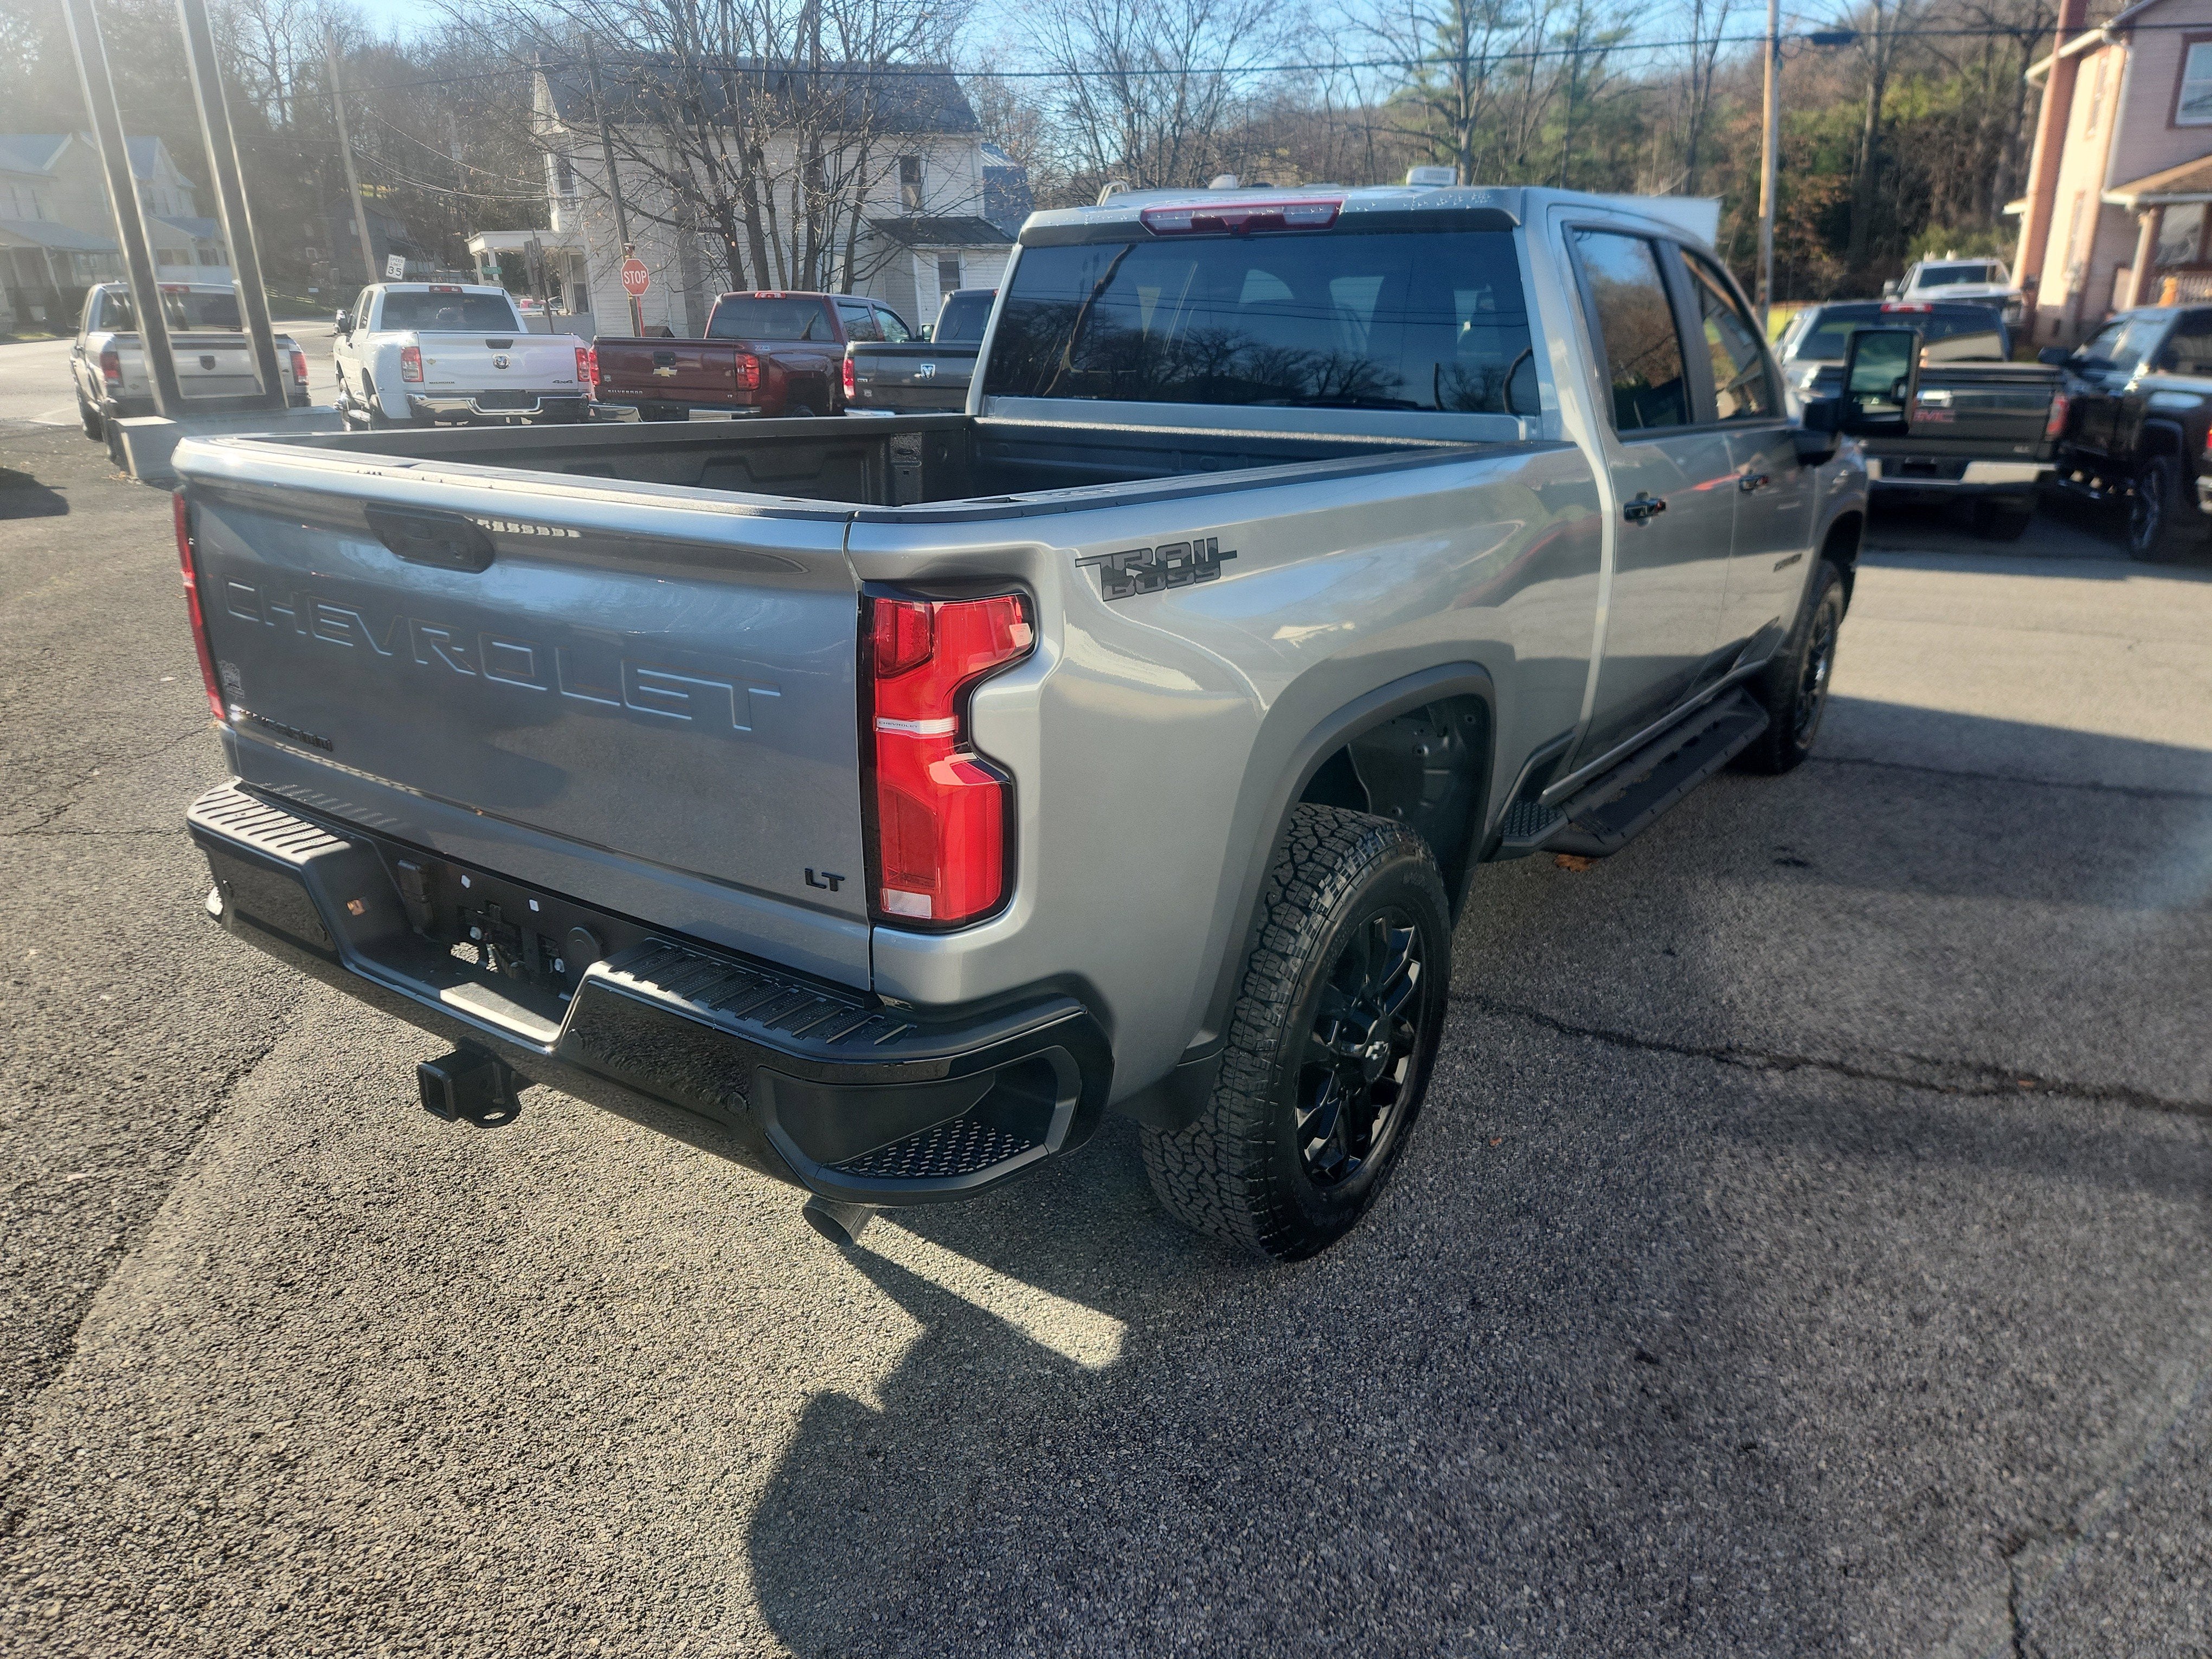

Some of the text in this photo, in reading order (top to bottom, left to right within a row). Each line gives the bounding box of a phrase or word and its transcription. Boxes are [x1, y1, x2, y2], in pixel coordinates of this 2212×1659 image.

[388, 266, 402, 276] 35
[623, 271, 647, 285] STOP
[223, 574, 781, 731] CHEVROLET
[879, 721, 918, 729] CHEVROLET
[805, 867, 845, 892] LT
